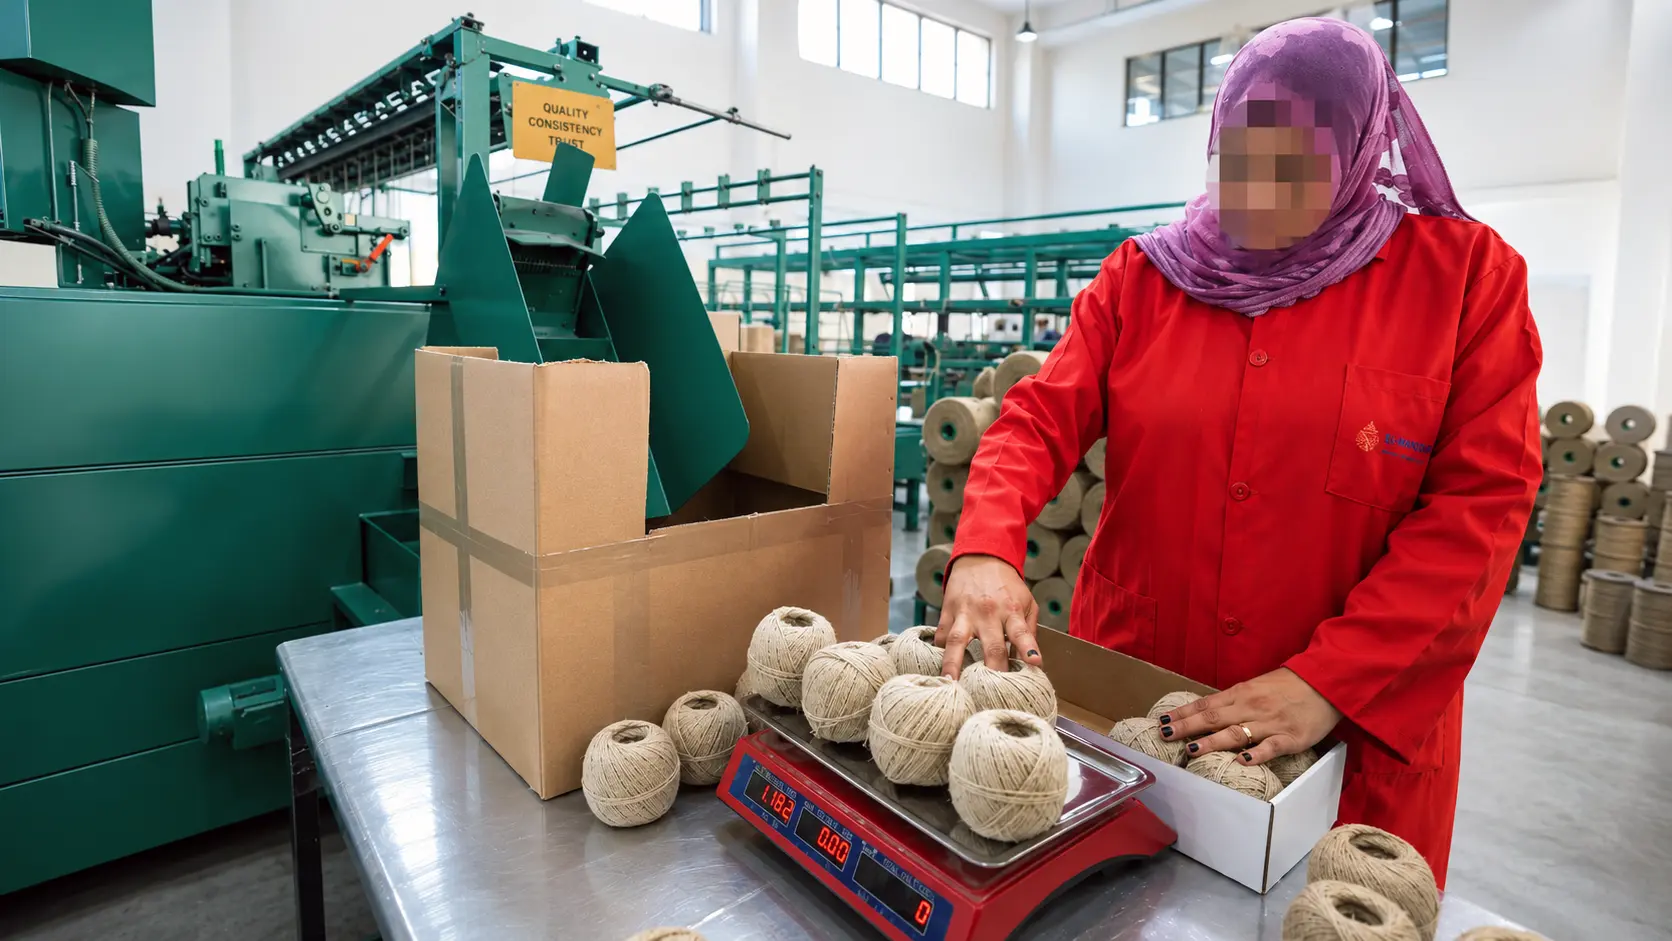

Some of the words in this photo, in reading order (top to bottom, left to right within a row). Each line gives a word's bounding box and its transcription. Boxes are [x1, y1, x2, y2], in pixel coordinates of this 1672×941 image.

[543, 103, 588, 119] QUALITY
[528, 117, 602, 136] CONSISTENCY
[762, 785, 795, 820] 1.182
[817, 826, 849, 864] 0.00
[914, 899, 931, 925] 0
